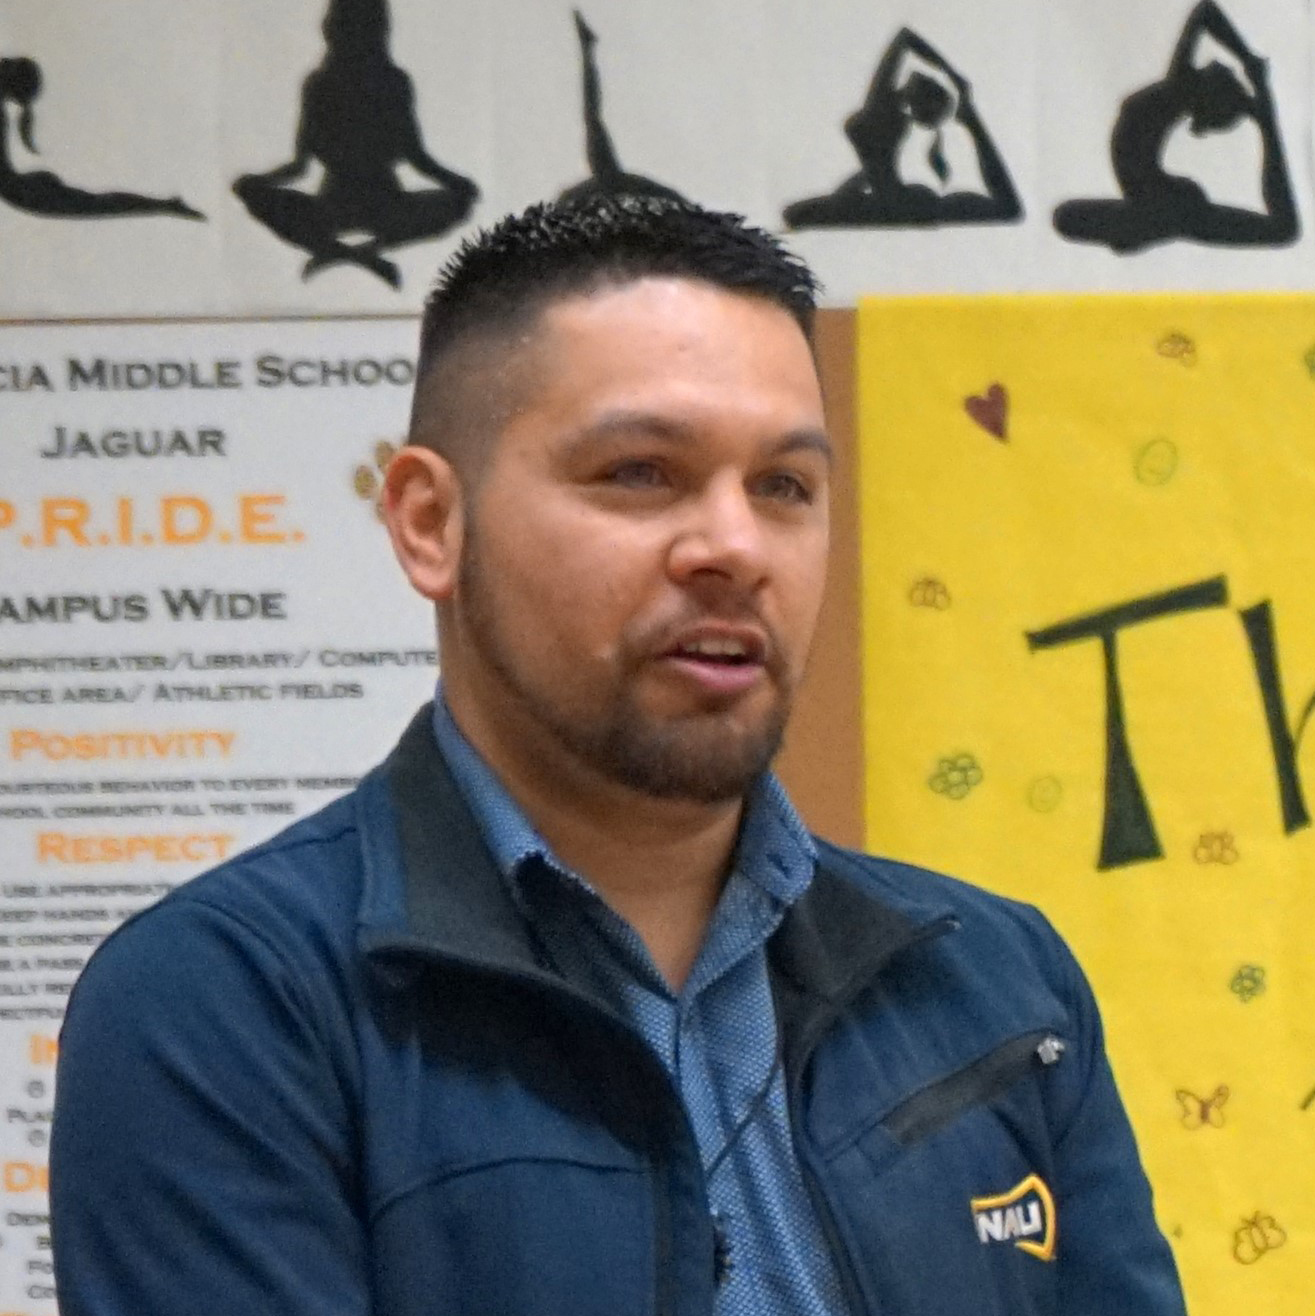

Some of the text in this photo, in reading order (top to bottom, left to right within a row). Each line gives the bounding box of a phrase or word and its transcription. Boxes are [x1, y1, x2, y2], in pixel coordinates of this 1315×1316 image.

[0, 364, 55, 392] IA
[66, 357, 242, 391] MIDDLE
[40, 425, 227, 459] JAGUAR
[161, 588, 288, 622] WIDE
[9, 728, 236, 762] POSITIVITY
[37, 831, 233, 863] RESPECT
